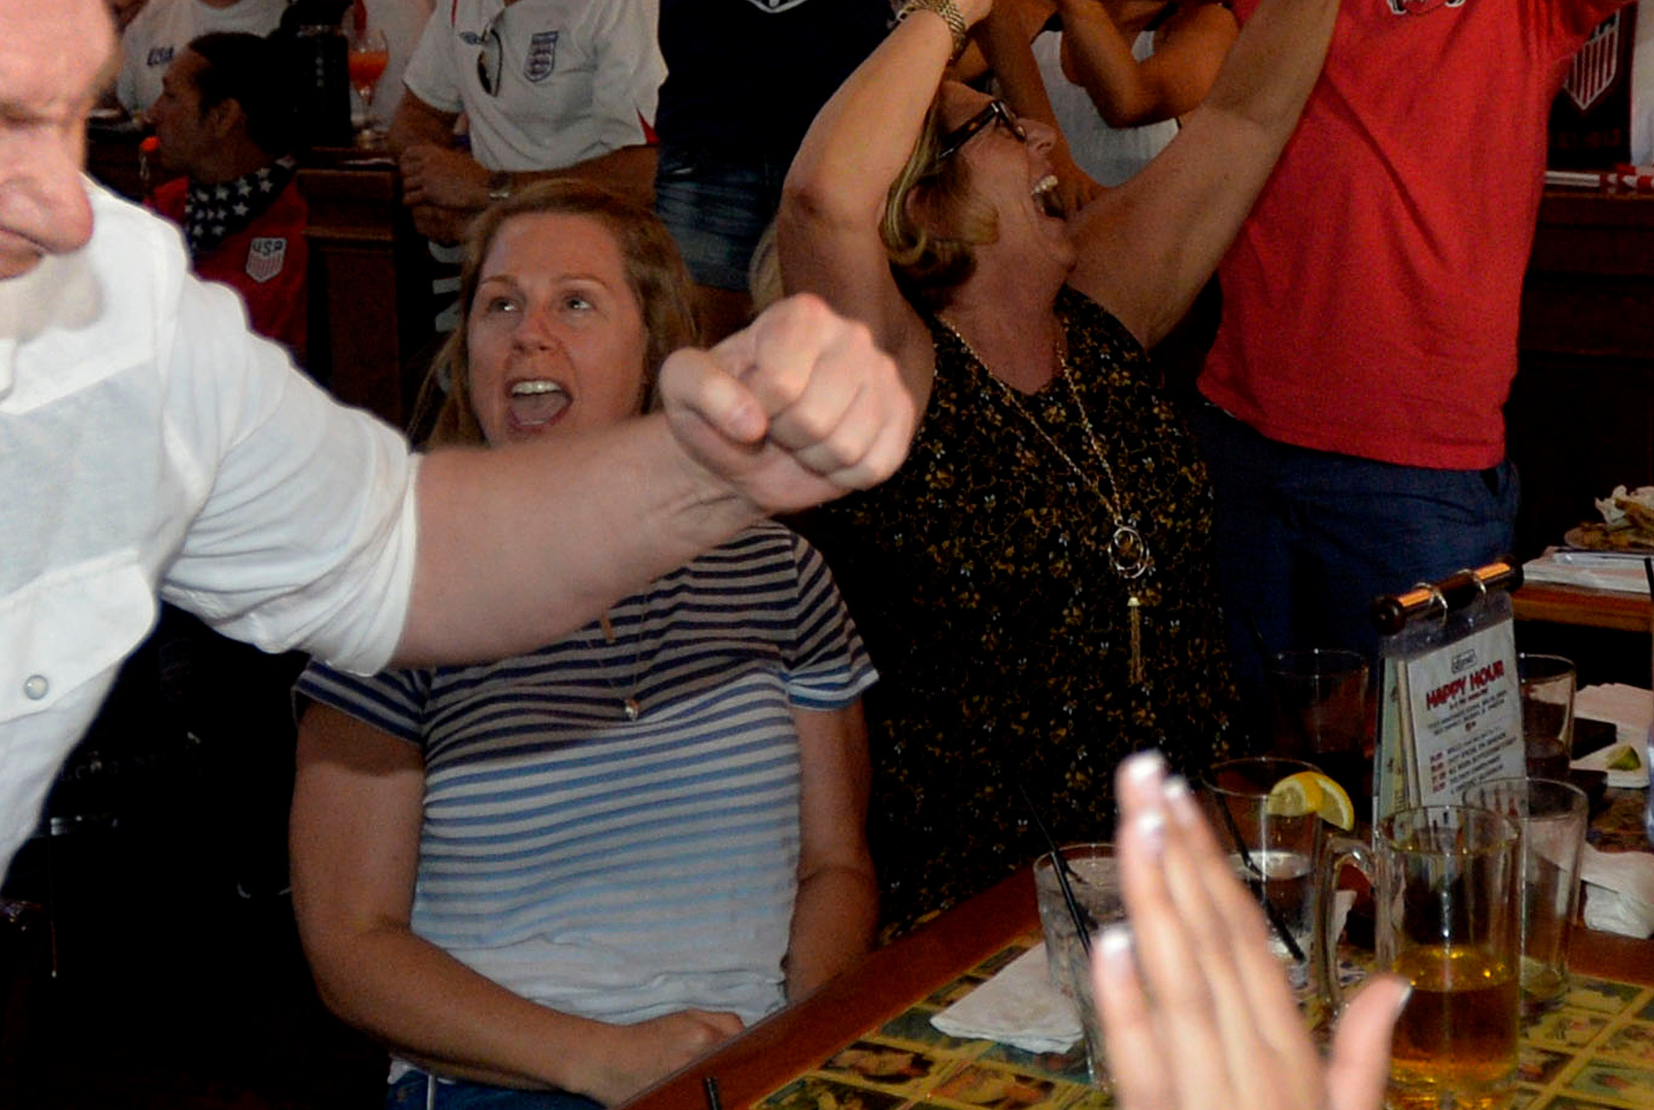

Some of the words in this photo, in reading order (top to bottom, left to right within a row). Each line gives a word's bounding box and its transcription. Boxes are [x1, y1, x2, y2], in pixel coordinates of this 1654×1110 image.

[251, 239, 285, 257] USA
[1425, 675, 1468, 712] HAPPY
[1469, 659, 1505, 691] HOUR
